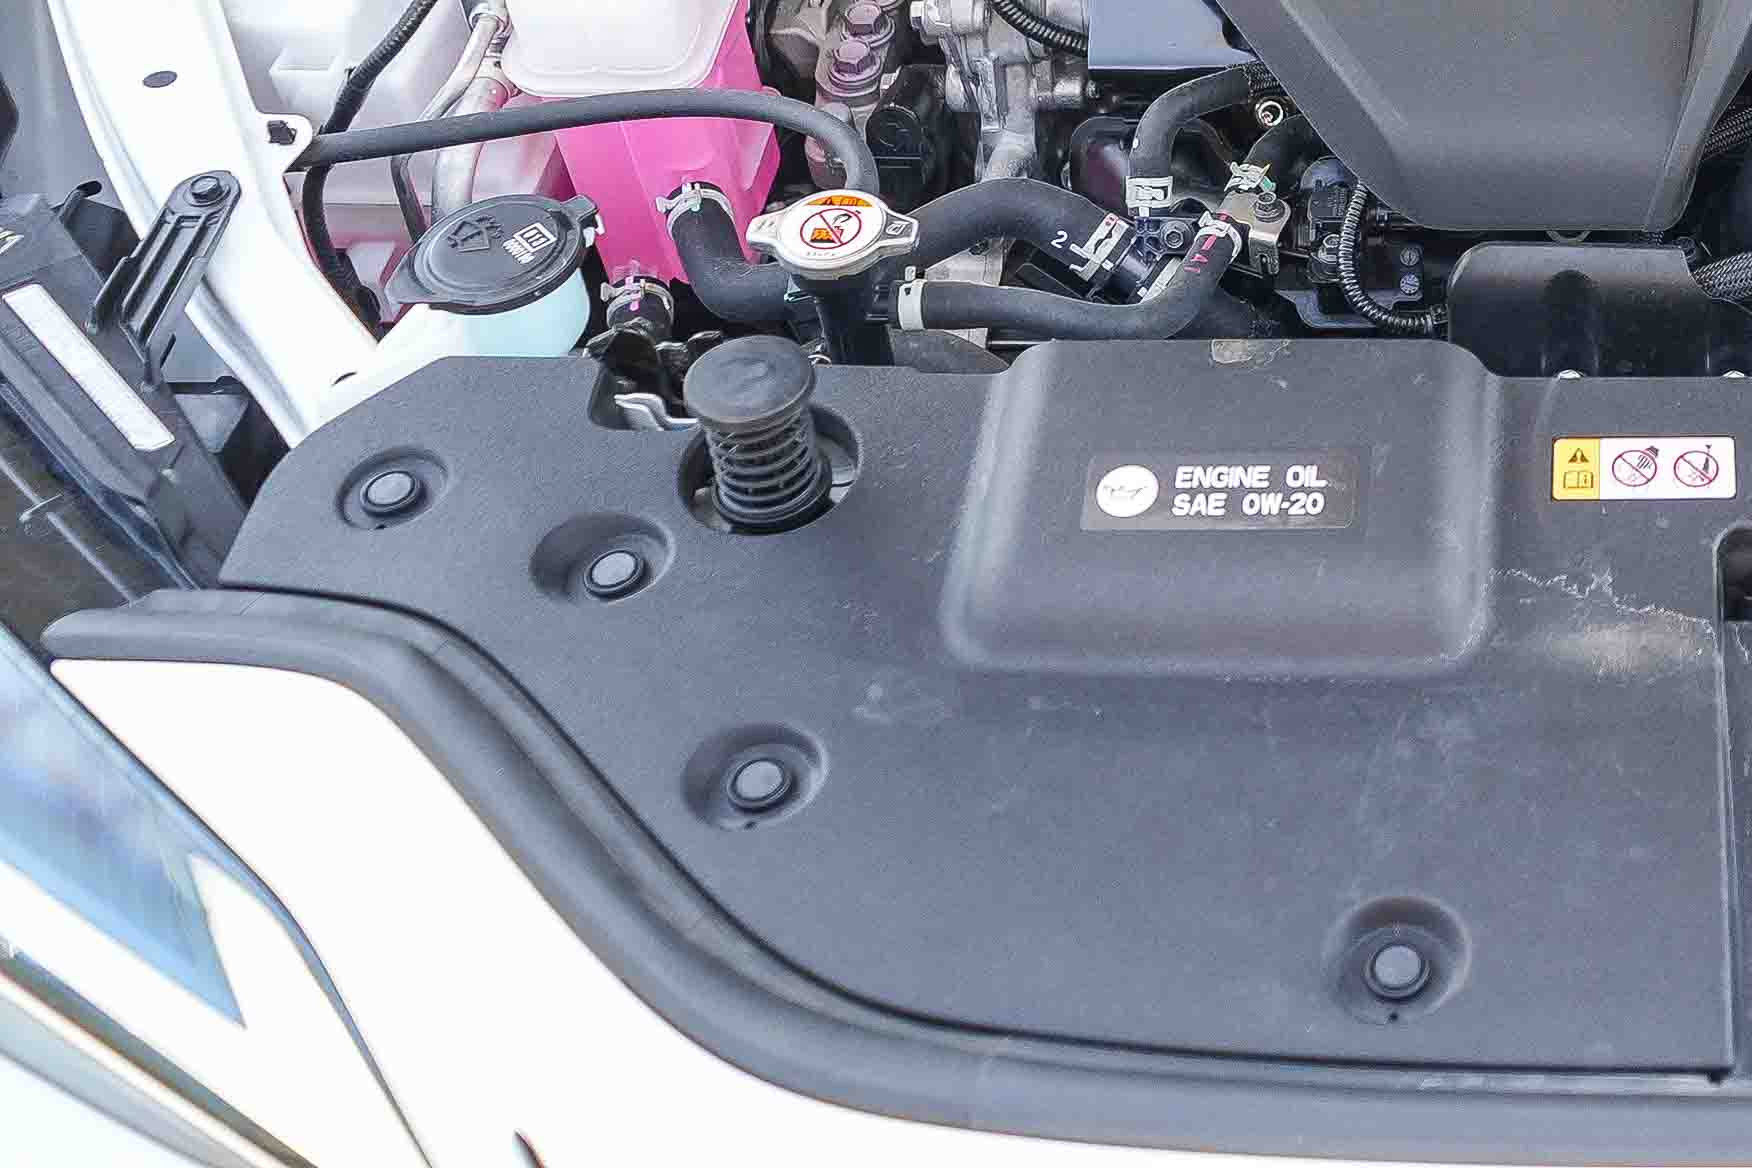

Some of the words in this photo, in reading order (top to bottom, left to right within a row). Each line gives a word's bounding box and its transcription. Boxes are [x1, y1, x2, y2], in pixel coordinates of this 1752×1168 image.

[1050, 230, 1069, 249] 2
[1174, 464, 1272, 489] ENGINE
[1285, 464, 1329, 489] OIL
[1171, 492, 1228, 518] SAE
[1241, 492, 1326, 517] 0W-20
